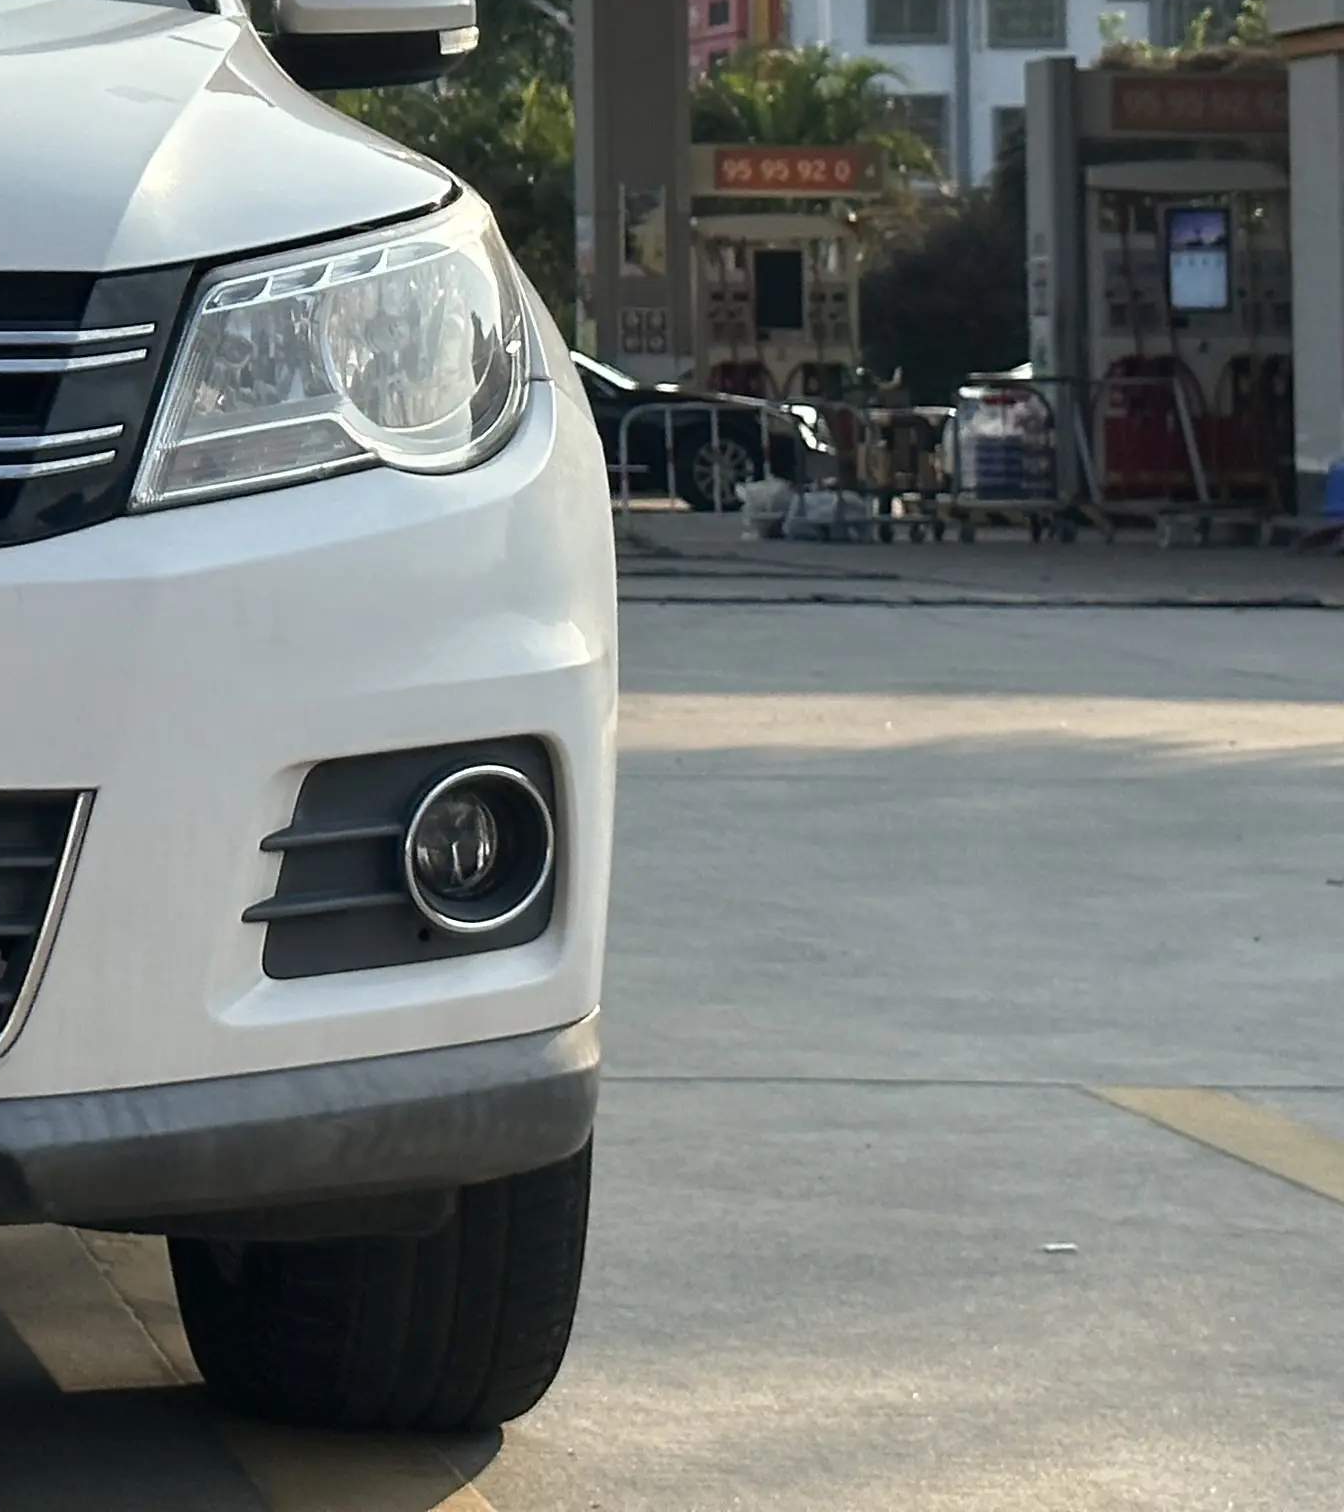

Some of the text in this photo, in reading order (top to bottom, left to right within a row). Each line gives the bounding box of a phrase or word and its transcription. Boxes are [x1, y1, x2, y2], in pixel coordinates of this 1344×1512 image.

[722, 158, 752, 183] 95
[760, 158, 790, 183] 95
[797, 158, 827, 182] 92
[834, 158, 852, 183] 0
